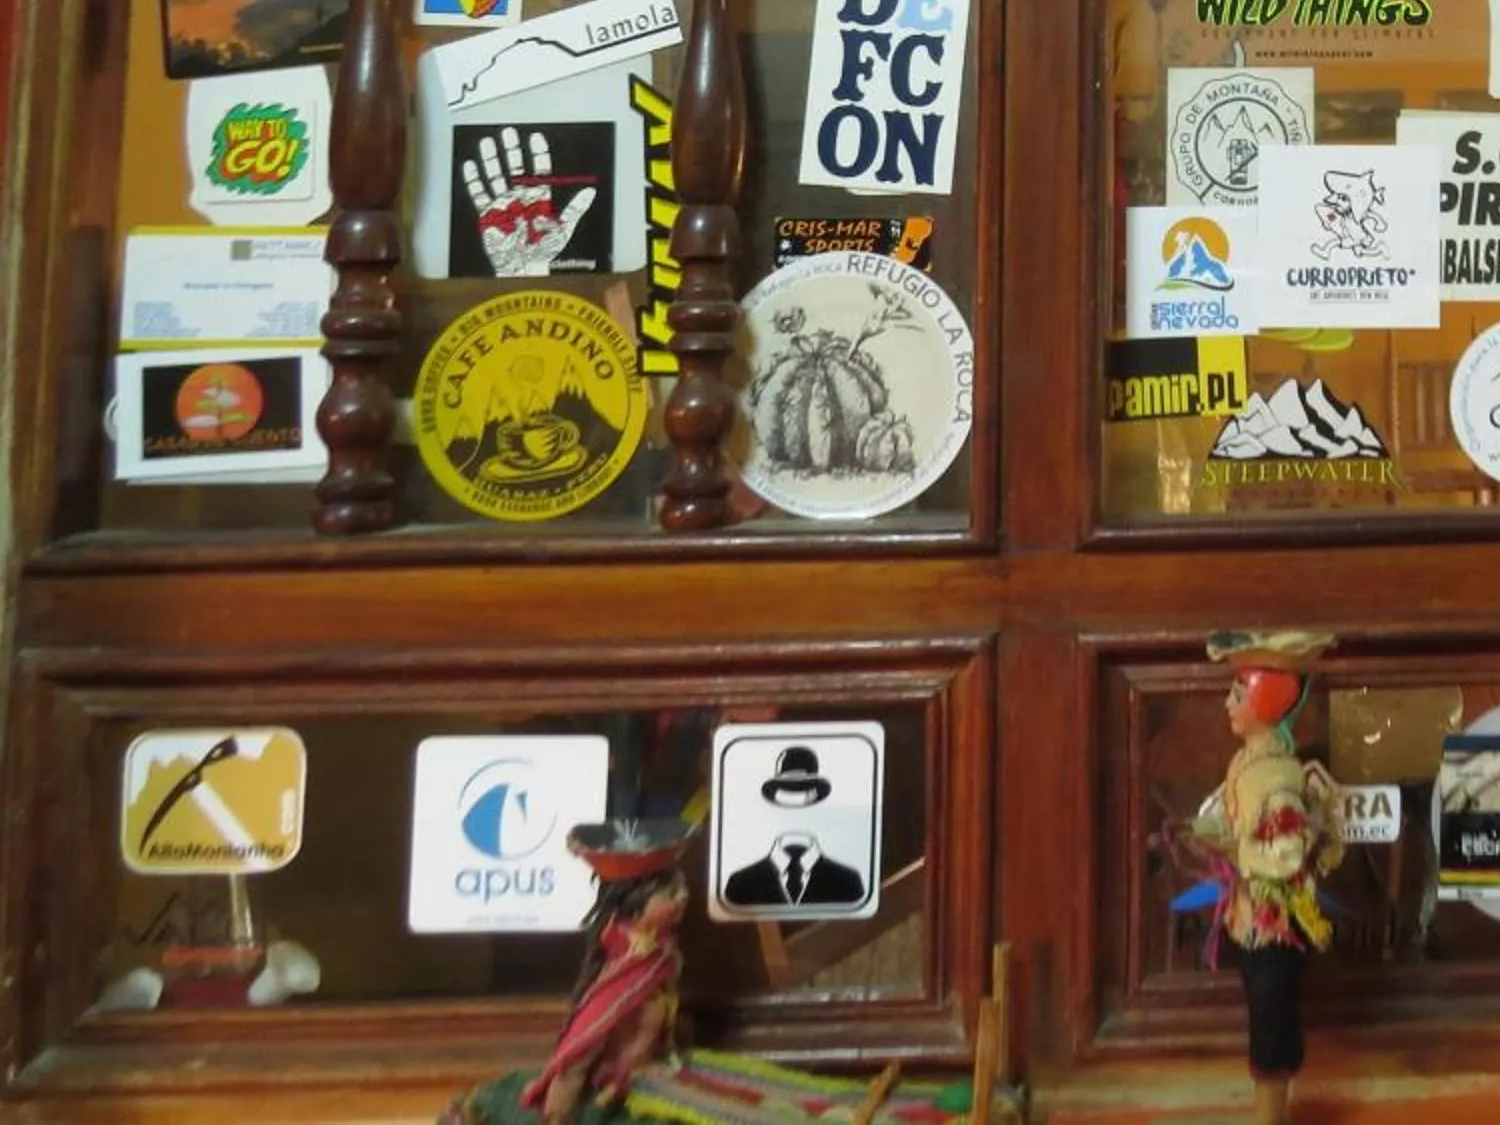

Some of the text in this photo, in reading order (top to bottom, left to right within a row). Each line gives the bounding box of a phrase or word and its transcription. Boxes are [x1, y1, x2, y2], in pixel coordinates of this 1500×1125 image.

[585, 1, 678, 47] lamola
[223, 138, 300, 179] GO!
[779, 219, 882, 238] CRIS-MAR
[846, 253, 973, 424] REFUGIO LA ROCA
[444, 317, 617, 411] CAFE ANDINO
[1202, 459, 1398, 485] STEEPWATER
[1345, 791, 1393, 820] RA
[454, 864, 556, 907] apus
